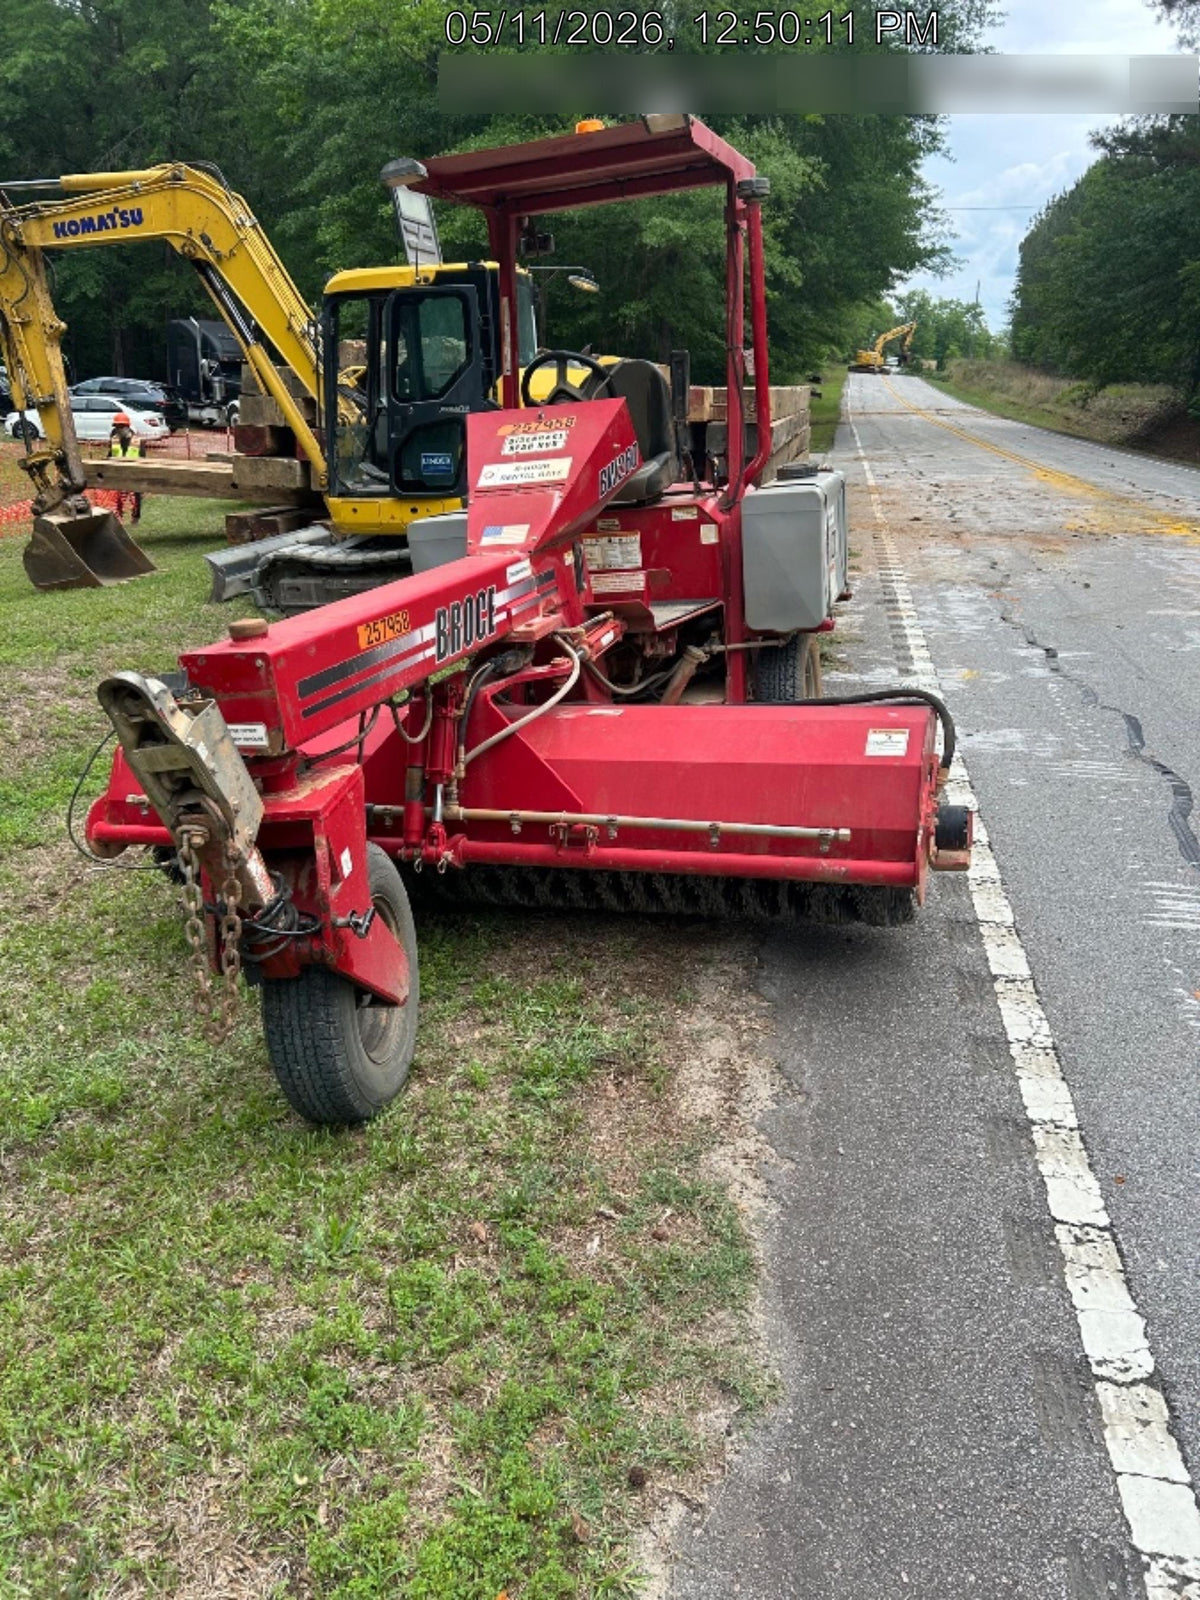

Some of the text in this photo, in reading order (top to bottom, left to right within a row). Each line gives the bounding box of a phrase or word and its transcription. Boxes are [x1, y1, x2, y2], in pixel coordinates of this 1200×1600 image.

[52, 206, 144, 239] KOMATSU
[364, 610, 410, 646] 257958
[435, 584, 497, 664] BROCE
